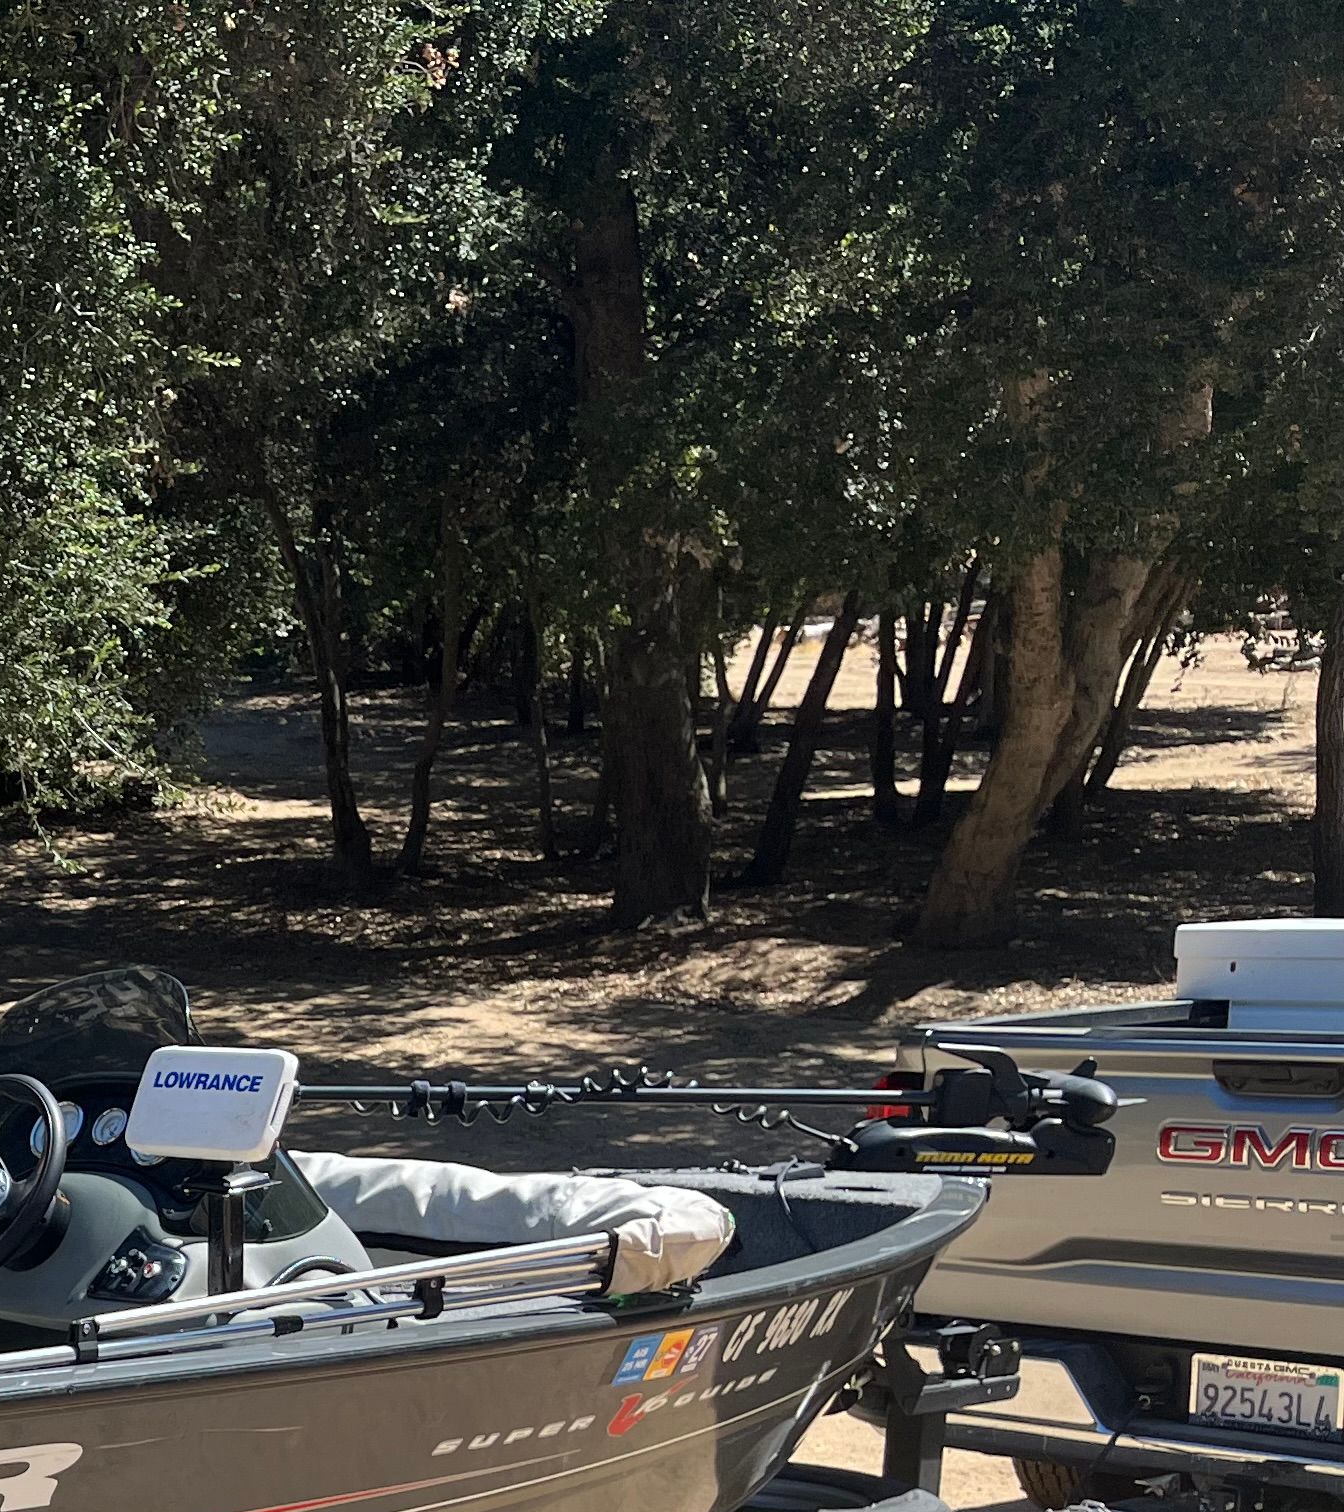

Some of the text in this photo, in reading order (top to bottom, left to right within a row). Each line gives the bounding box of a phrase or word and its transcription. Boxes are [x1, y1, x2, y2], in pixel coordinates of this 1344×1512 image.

[153, 1071, 264, 1093] LOWRANCE
[977, 1152, 1035, 1165] KOTA
[1160, 1191, 1344, 1215] SIERR
[722, 1287, 854, 1362] CF 9630 RX
[688, 1332, 718, 1363] 27
[1203, 1383, 1333, 1433] 92543L4
[431, 1414, 596, 1457] SUPER
